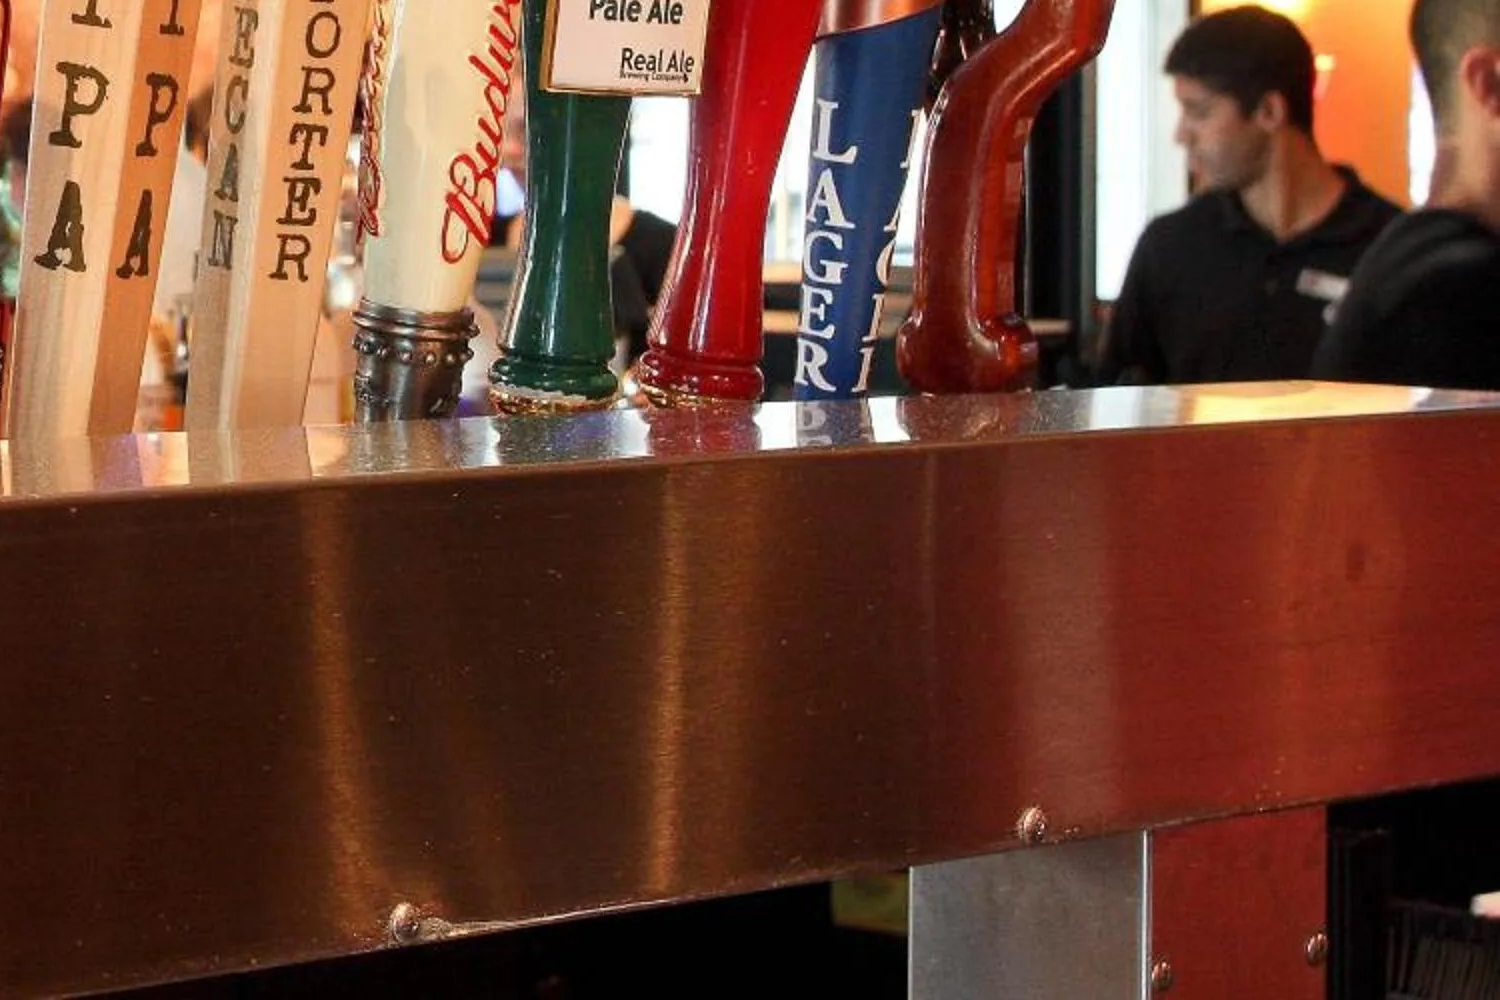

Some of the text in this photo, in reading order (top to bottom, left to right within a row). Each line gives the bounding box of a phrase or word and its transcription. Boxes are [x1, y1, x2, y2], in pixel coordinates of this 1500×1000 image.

[621, 47, 695, 73] Real Ale
[793, 98, 858, 393] LAGER
